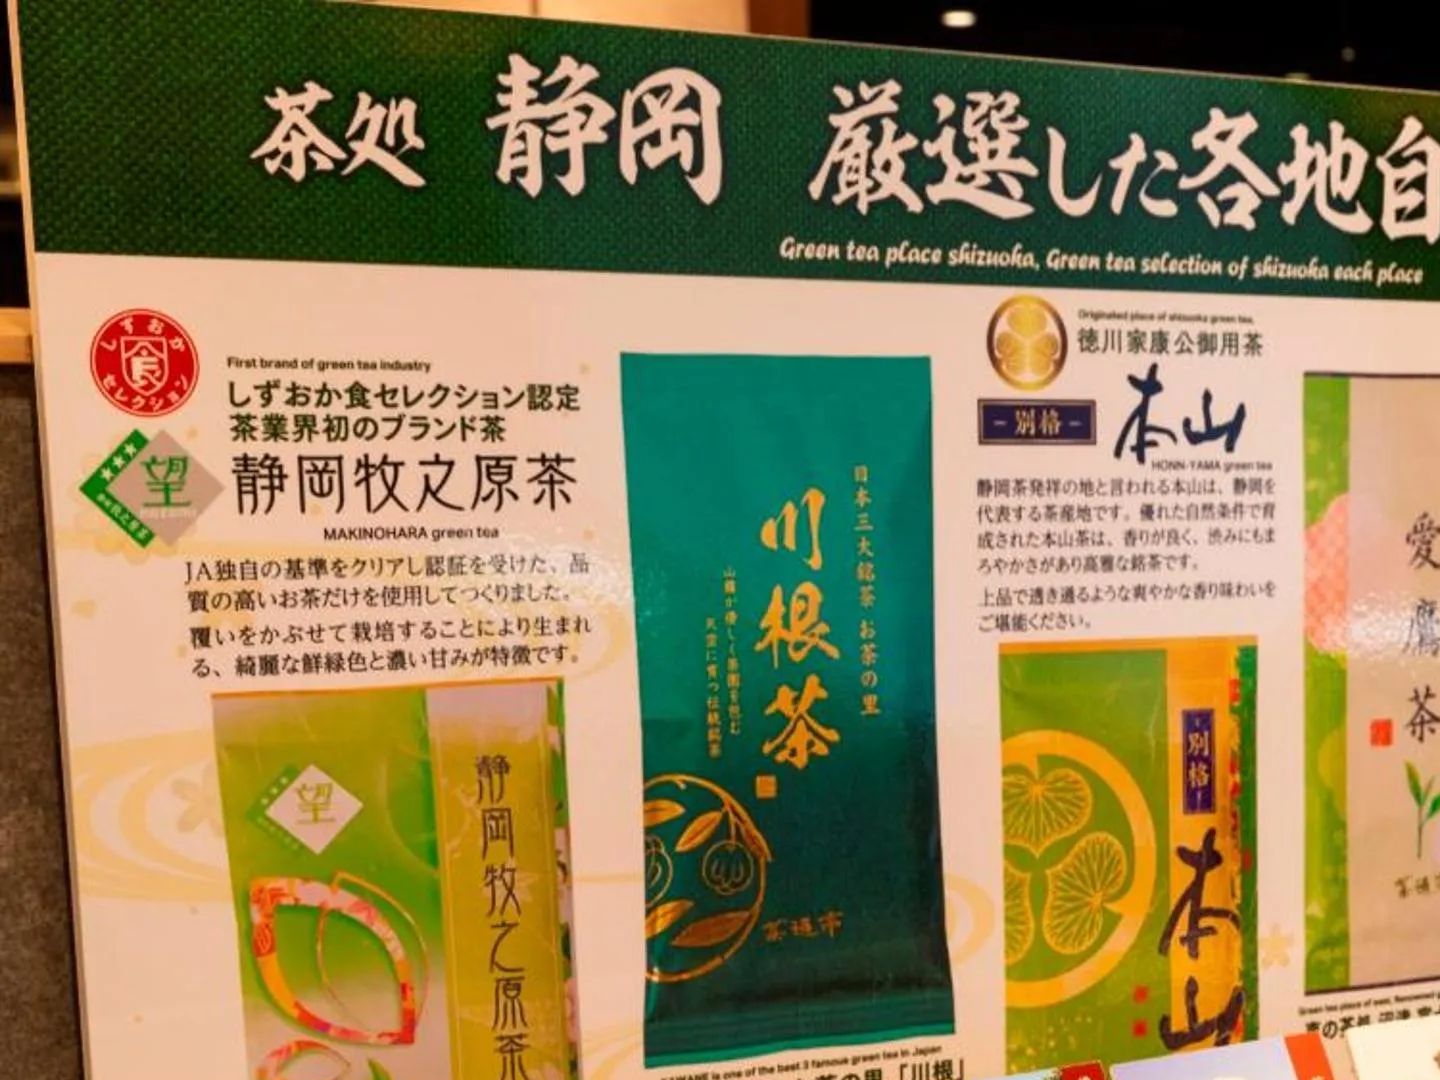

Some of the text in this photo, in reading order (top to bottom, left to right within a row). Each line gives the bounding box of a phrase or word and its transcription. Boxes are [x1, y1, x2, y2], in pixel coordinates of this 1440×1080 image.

[250, 80, 426, 188] 茶処
[484, 52, 722, 205] 静岡
[779, 236, 1424, 288] Green tea place shizuoka, Green tea selection of shizuoka each place
[1077, 327, 1264, 357] 徳川家康公御用茶
[227, 356, 431, 374] First brand of green tea industry
[227, 379, 581, 413] しずおか食セレクション認定
[229, 413, 506, 443] 茶業界初のブランド茶
[231, 452, 577, 515] 静岡牧之原茶
[323, 526, 499, 543] MAKINOHARA green tea
[754, 487, 841, 770] 川根茶
[744, 1066, 757, 1078] of
[757, 1064, 775, 1077] the
[777, 1061, 800, 1074] best
